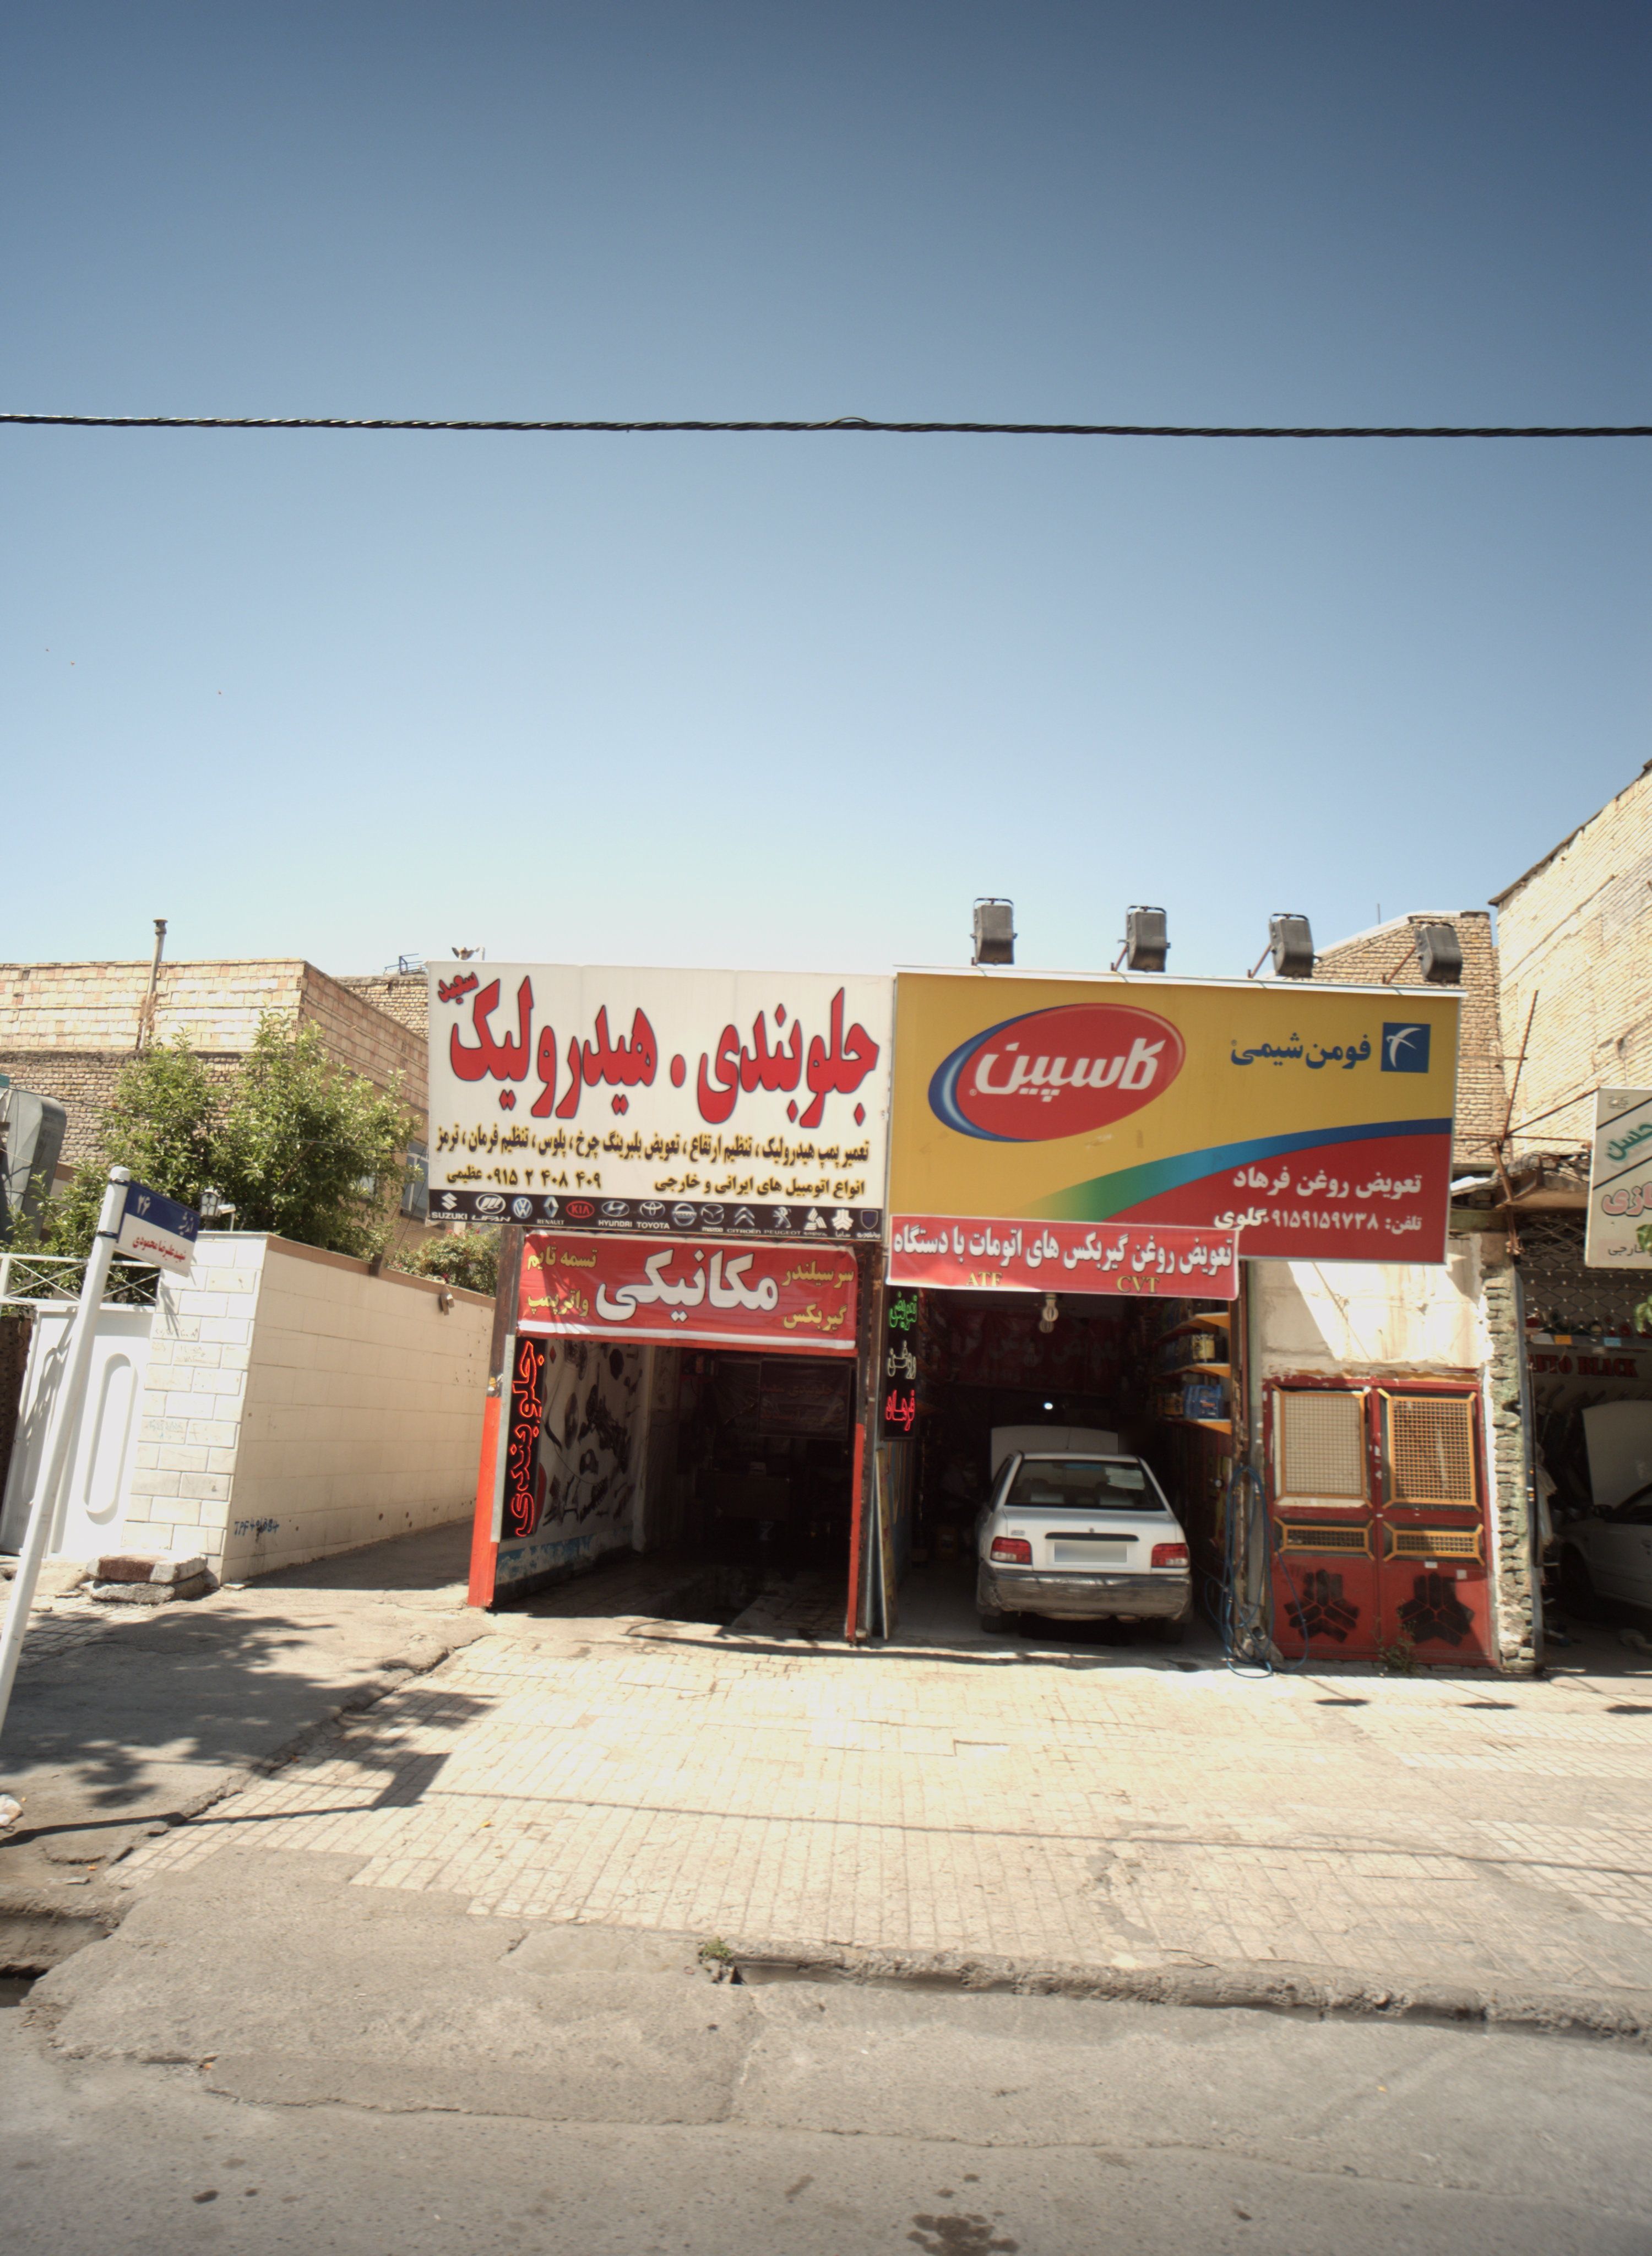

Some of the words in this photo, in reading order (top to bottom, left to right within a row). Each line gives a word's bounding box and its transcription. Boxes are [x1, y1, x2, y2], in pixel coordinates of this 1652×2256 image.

[438, 972, 479, 1004] سعید
[449, 975, 658, 1119] هیدرولیک
[697, 986, 880, 1127] جلوبندی
[1231, 1032, 1304, 1066] شیمی
[1306, 1033, 1371, 1070] فومن
[975, 1038, 1166, 1102] کاسپین
[437, 1124, 459, 1152] ترمز
[501, 1125, 529, 1154] تنظیم
[603, 1129, 642, 1159] بلبرینگ
[644, 1132, 680, 1162] تعویض
[724, 1135, 753, 1164] تنظیم
[818, 1144, 840, 1169] پمپ
[841, 1139, 870, 1168] تعمیر
[447, 1164, 482, 1183] عظیمی
[487, 1168, 518, 1185] ۰۹۱۵
[525, 1169, 534, 1186] ۲
[541, 1169, 568, 1188] ۴۰۸
[576, 1171, 601, 1189] ۴۰۹
[654, 1173, 700, 1194] خارجی
[703, 1179, 712, 1194] و
[715, 1174, 754, 1195] ایرانی
[757, 1176, 782, 1197] های
[786, 1176, 830, 1198] اتومبیل
[1233, 1165, 1291, 1195] فرهاد
[1296, 1169, 1349, 1198] روغن
[1355, 1172, 1422, 1200] تعویض
[833, 1179, 865, 1200] انواع
[432, 1212, 468, 1221] SUZUKI
[572, 1205, 590, 1214] KIA
[1263, 1210, 1379, 1230] ۰۹۱۵۹۱۵۹۷۳۸
[893, 1223, 949, 1255] دستگاه
[953, 1224, 965, 1264] با
[969, 1226, 1023, 1267] اتومات
[1025, 1229, 1059, 1268] های
[527, 1245, 557, 1271] تایم
[561, 1249, 598, 1268] تسمه
[1132, 1234, 1175, 1274] روغن
[1179, 1237, 1233, 1276] تعویض
[595, 1247, 780, 1322] مکانیکی
[966, 1271, 1003, 1287] ATF
[1116, 1276, 1160, 1293] CVT
[889, 1290, 918, 1331] تعویض
[887, 1340, 917, 1379] روغن
[1577, 1356, 1638, 1378] BLACK
[885, 1389, 916, 1431] فرهاد
[511, 1340, 545, 1537] جلوبندی
